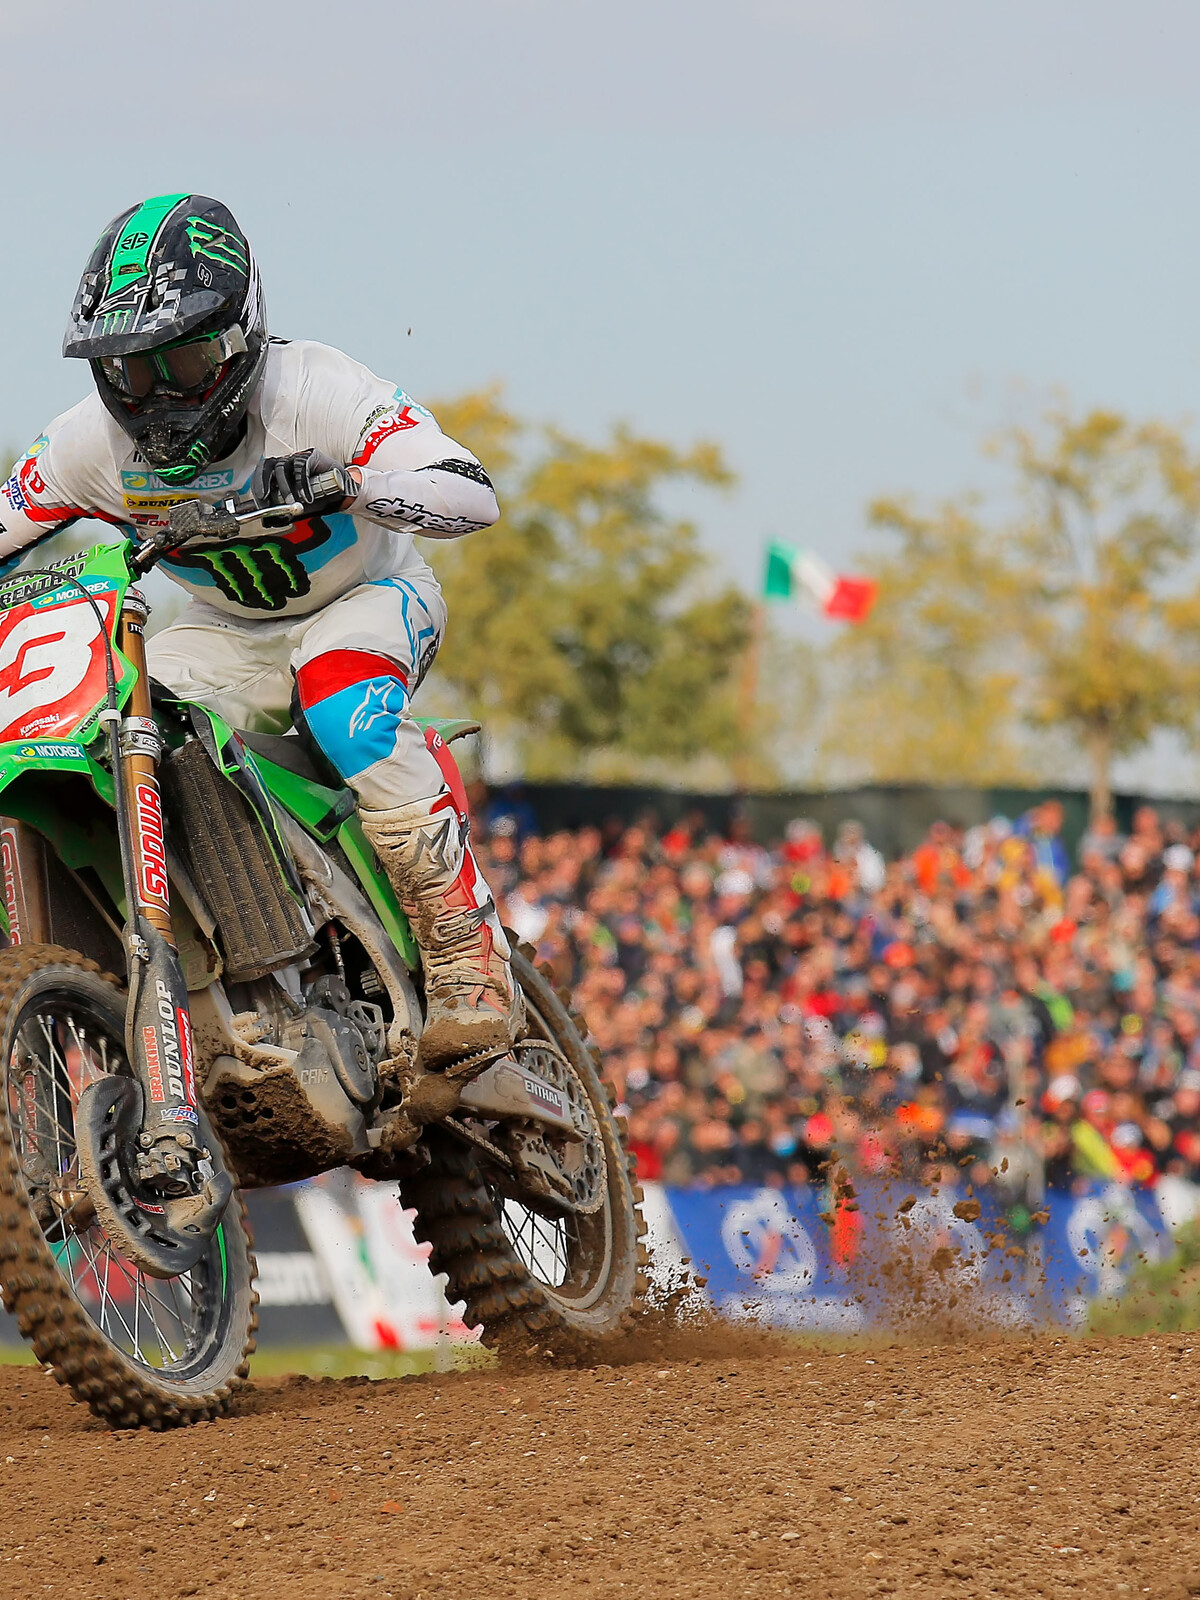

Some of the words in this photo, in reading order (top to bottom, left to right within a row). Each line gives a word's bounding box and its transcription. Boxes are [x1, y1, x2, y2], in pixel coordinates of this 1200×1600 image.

[19, 712, 60, 736] Kawasaki
[36, 745, 85, 758] MOTOREX
[136, 784, 170, 906] SHOWA
[143, 1025, 166, 1104] BRAKING
[155, 979, 186, 1101] DUNLOP
